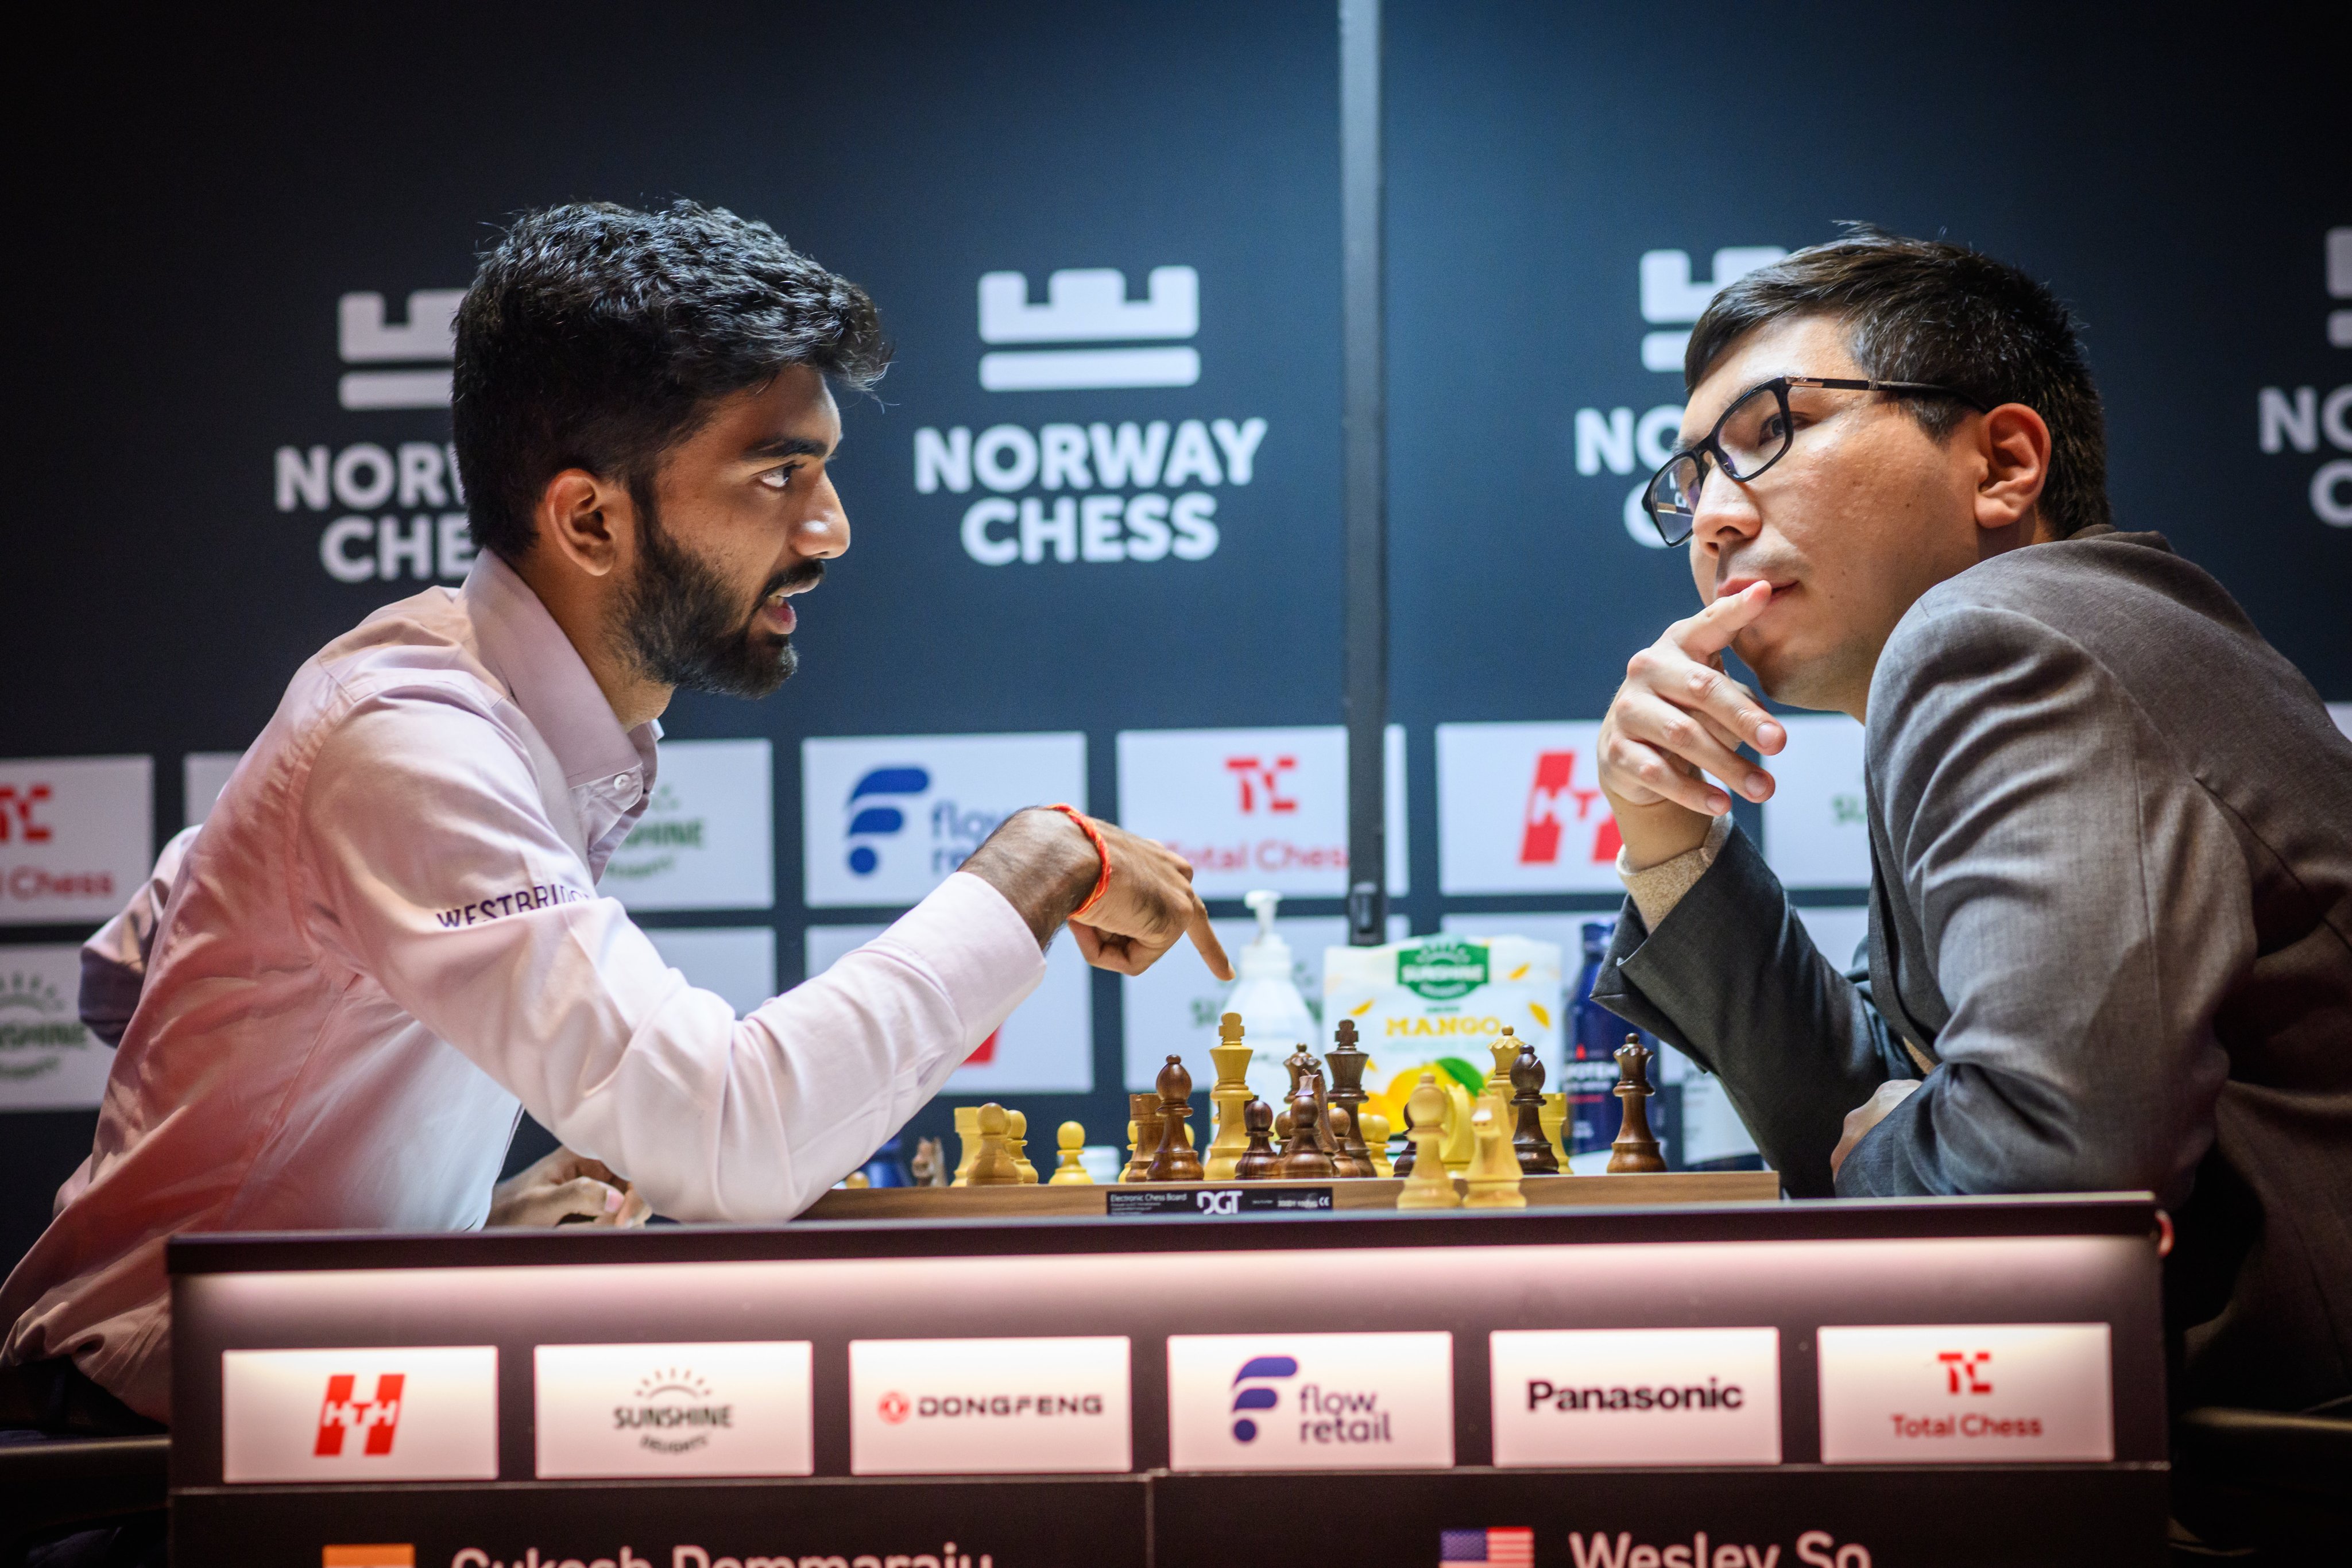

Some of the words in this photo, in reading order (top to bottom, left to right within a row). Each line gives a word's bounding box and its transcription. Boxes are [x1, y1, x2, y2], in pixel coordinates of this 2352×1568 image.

[914, 417, 1267, 494] NORWAY
[274, 443, 461, 512] NOR
[961, 491, 1219, 566] CHESS
[319, 516, 474, 583] CHE
[1226, 757, 1297, 811] TC
[1255, 837, 1348, 874] Ches
[1386, 1017, 1500, 1036] MANGO
[1197, 1190, 1243, 1215] DGT
[1937, 1352, 1993, 1394] TC
[919, 1394, 1103, 1416] DONGFENG
[1300, 1384, 1376, 1414] flow
[1527, 1376, 1743, 1412] Panasonic
[613, 1405, 733, 1429] SUNSHINE
[1300, 1412, 1392, 1443] retail
[1891, 1414, 1955, 1437] Total
[1960, 1413, 2042, 1437] Chess
